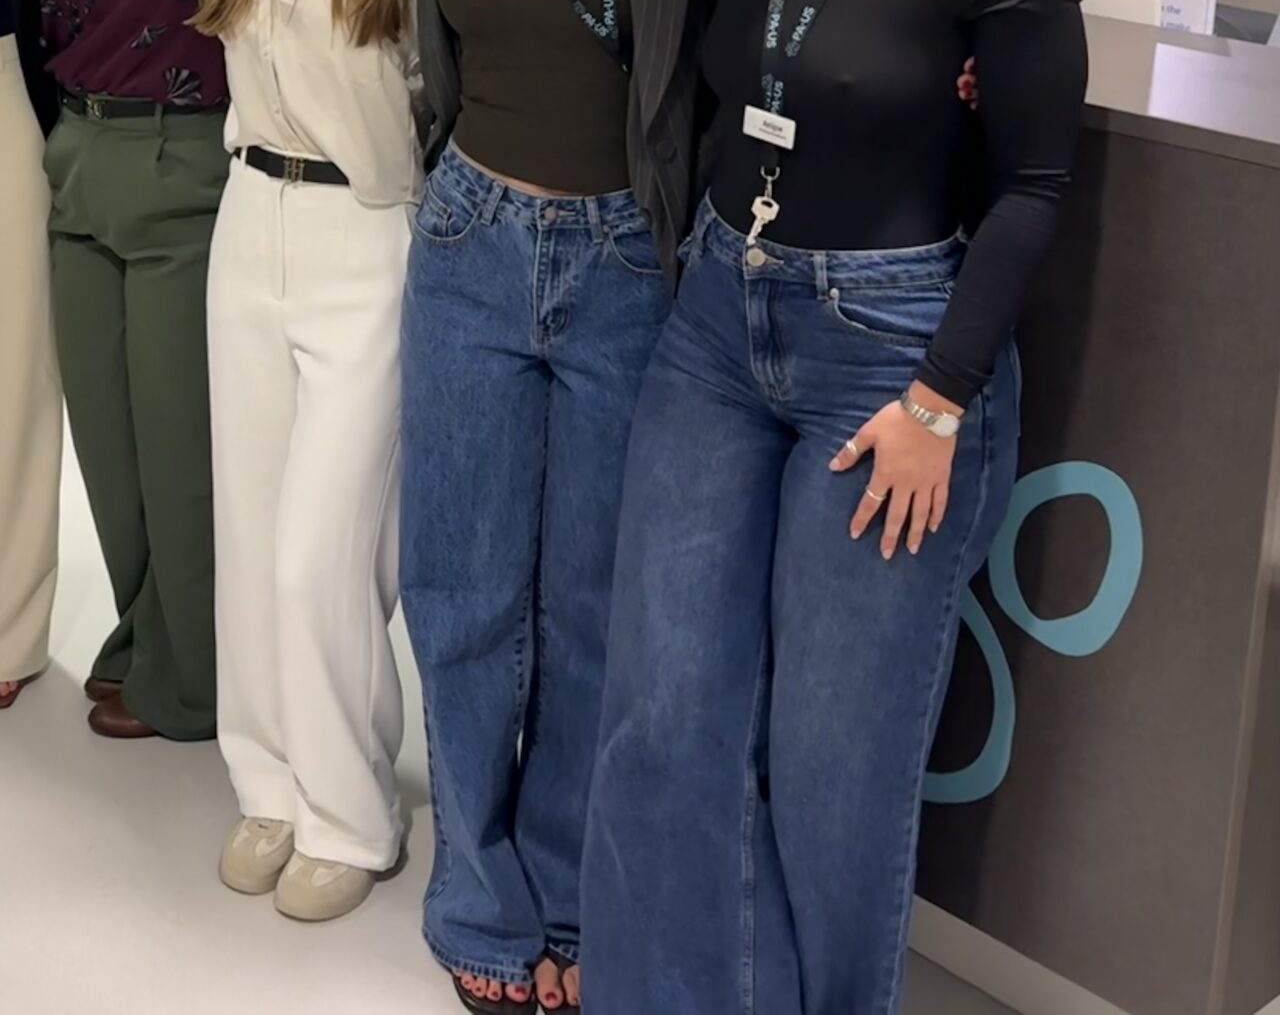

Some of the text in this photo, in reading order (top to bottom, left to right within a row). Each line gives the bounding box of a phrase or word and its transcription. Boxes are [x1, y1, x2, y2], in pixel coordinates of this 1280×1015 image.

[581, 12, 609, 37] PA-US
[766, 13, 781, 49] PA-US
[792, 6, 815, 41] PA-US
